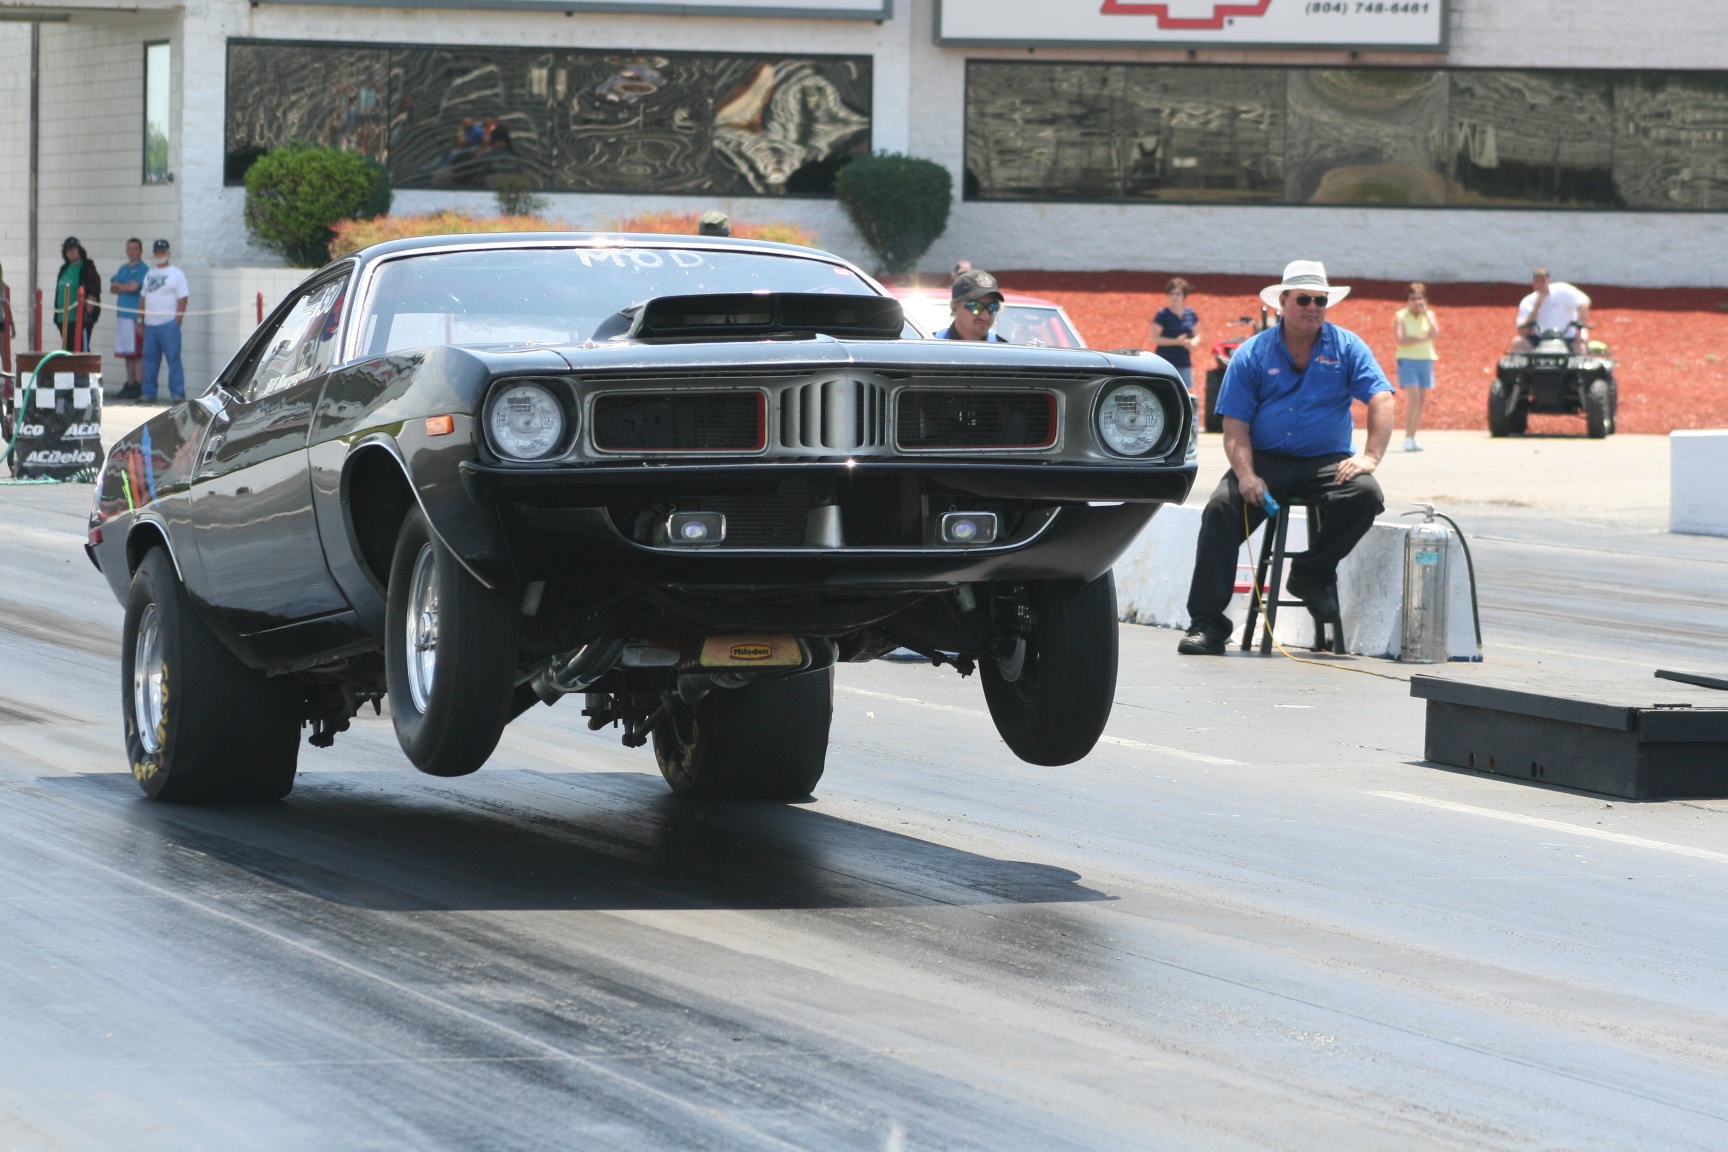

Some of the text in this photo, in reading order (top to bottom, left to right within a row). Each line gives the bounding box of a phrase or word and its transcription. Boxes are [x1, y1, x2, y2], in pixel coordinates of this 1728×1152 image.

[1305, 2, 1347, 15] (804)
[575, 248, 703, 267] MOD
[64, 423, 101, 436] ACD
[26, 449, 96, 463] ACDelco
[733, 648, 769, 656] Milodon
